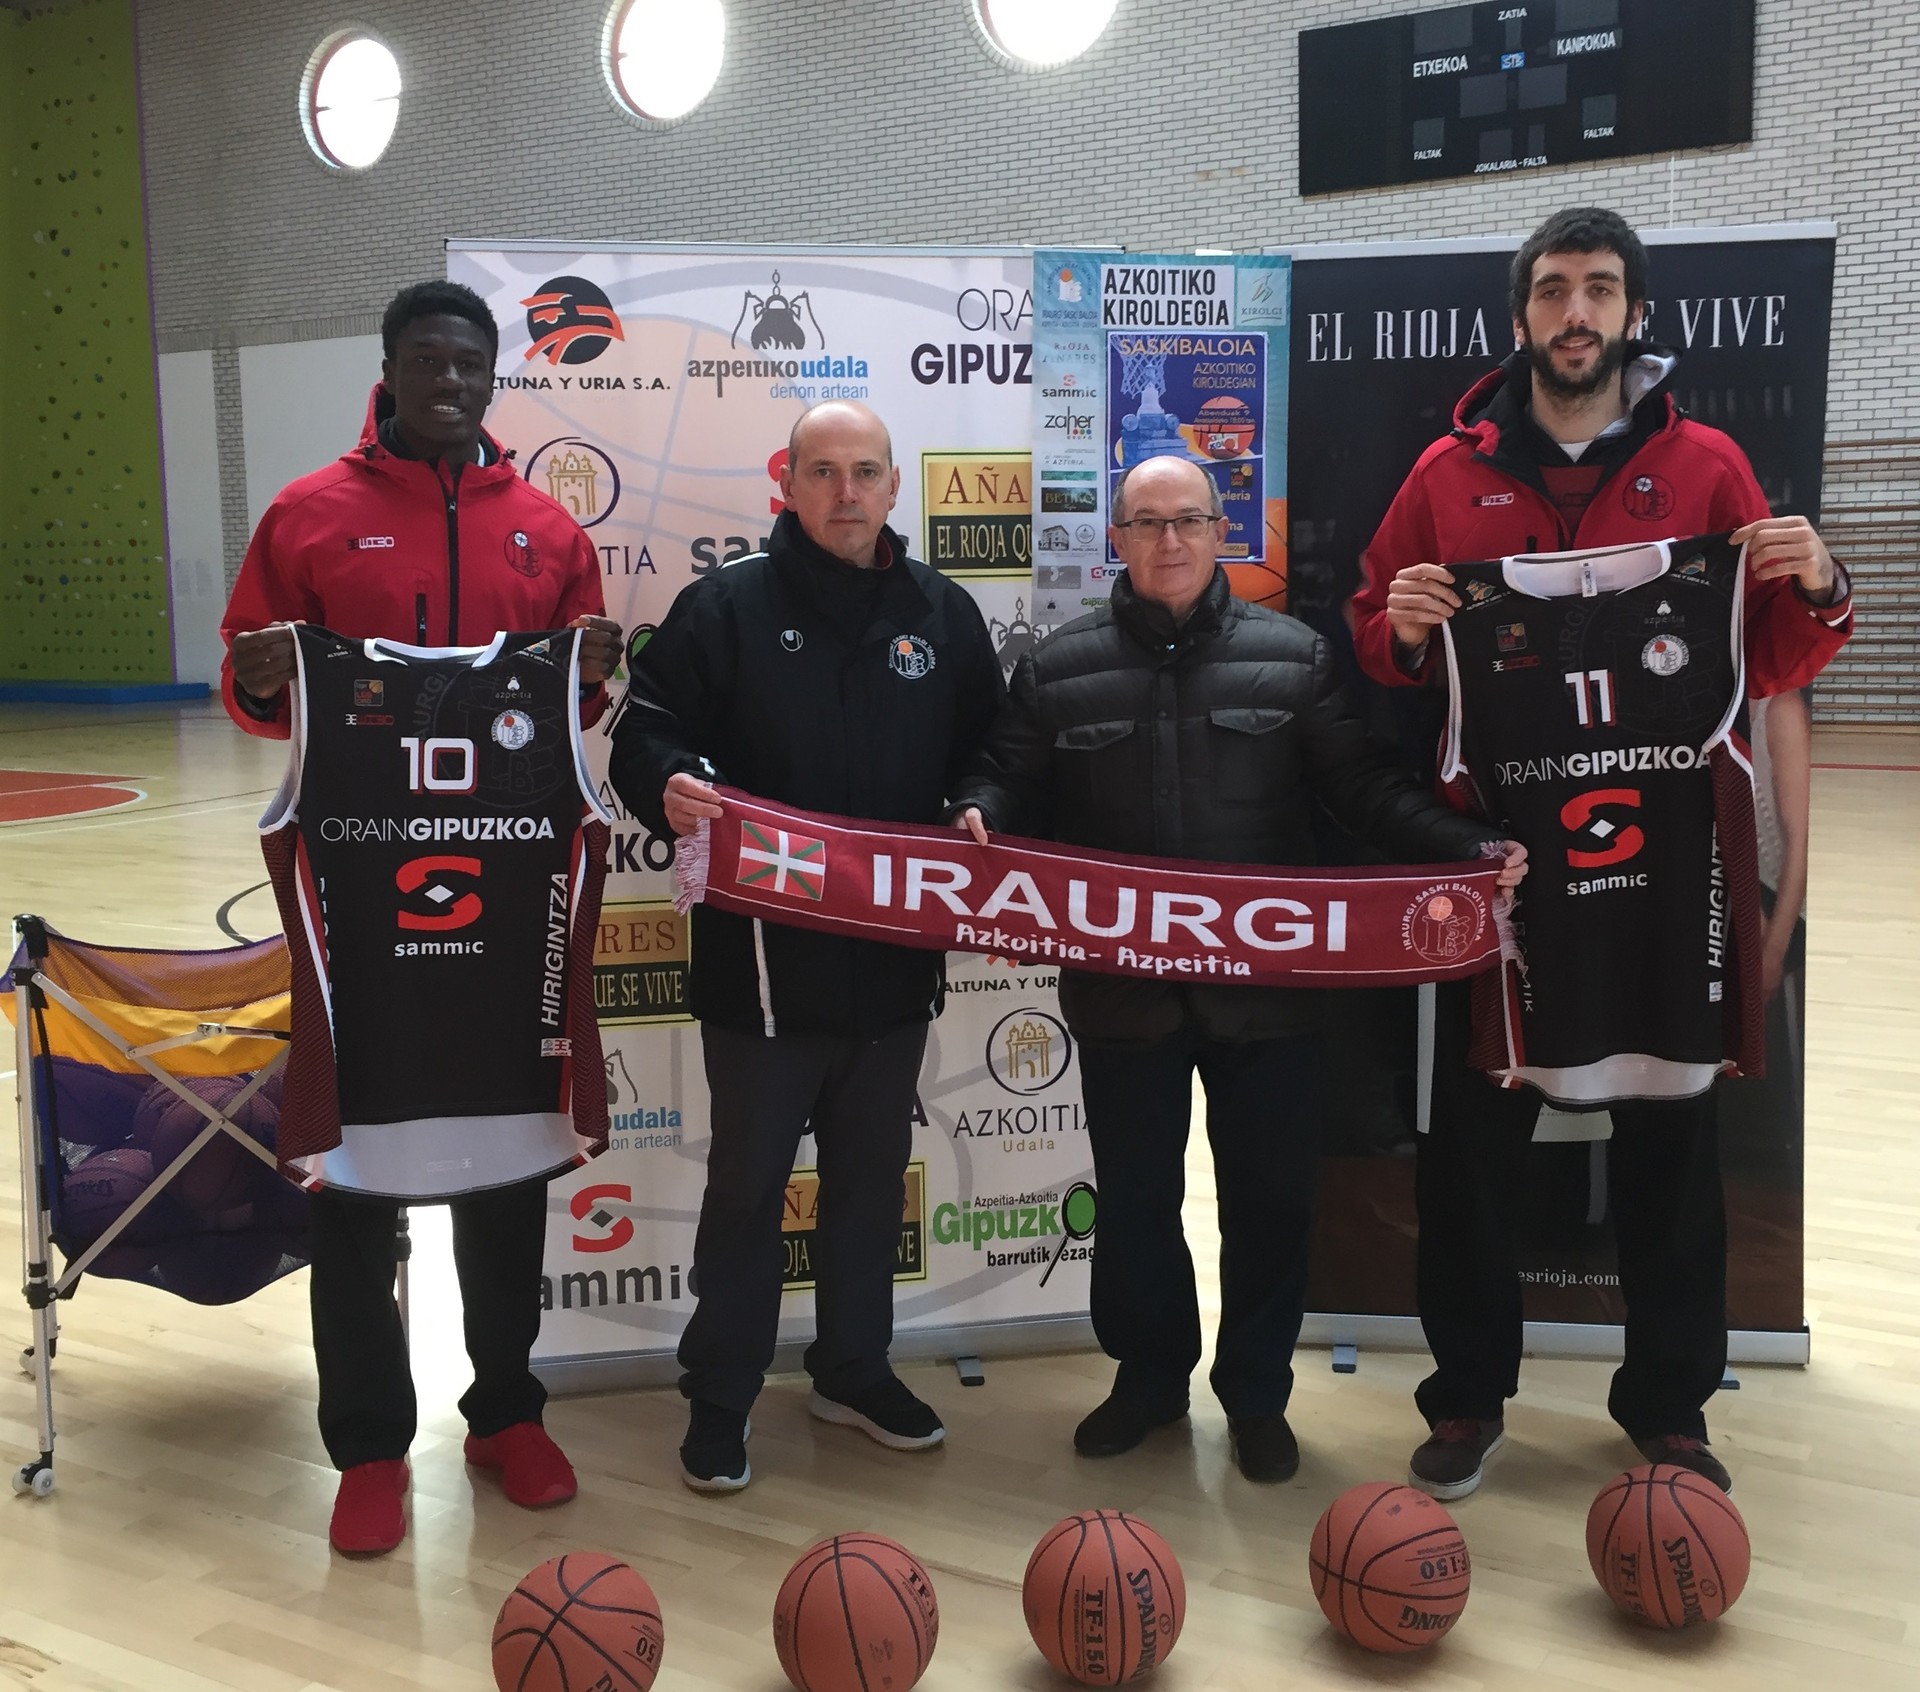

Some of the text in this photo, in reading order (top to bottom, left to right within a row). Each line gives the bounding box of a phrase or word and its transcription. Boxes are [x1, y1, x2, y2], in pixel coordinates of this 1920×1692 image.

[1498, 8, 1527, 20] ZATIA
[1556, 32, 1616, 55] KANPOKOA
[1413, 55, 1468, 77] ETXEKOA
[1584, 126, 1614, 139] FALTAK
[1414, 148, 1442, 160] FALTAK
[1104, 268, 1216, 295] AZKOITIKO
[957, 287, 1033, 332] ORA
[1103, 299, 1229, 326] KIROLDEGIA
[1241, 307, 1283, 315] KIROLGI
[1307, 311, 1353, 362] EL
[1373, 307, 1495, 360] RIOJA
[1676, 294, 1786, 349] VIVE
[1120, 338, 1256, 356] SASKIBALOIA
[911, 342, 1033, 385] GIPUZ
[1193, 362, 1256, 375] AZKOITIKO
[559, 377, 573, 390] Y
[579, 377, 625, 390] URIA
[634, 377, 671, 390] S.A.
[770, 382, 869, 399] denon artean
[1042, 387, 1097, 398] sammic
[1192, 376, 1256, 389] KIROLDEGIAN
[1044, 406, 1095, 435] zaher
[939, 463, 1030, 505] AÑA
[937, 522, 1033, 560] EL RIOJA QU
[1565, 669, 1616, 729] 11
[400, 737, 478, 794] 10
[320, 816, 555, 842] ORAINGIPUZKOA
[1567, 873, 1648, 896] sammic
[873, 853, 1347, 953] IRAURGI
[1401, 903, 1417, 951] IRAURGI
[1415, 883, 1449, 903] SASKI
[1452, 882, 1482, 902] BALOI
[394, 941, 484, 957] sammic
[541, 873, 570, 1027] HIRIGINTZA
[1118, 946, 1251, 977] Azpeitia
[594, 971, 684, 1010] UE SE VIVE
[1016, 977, 1030, 991] Y
[1035, 976, 1058, 990] UR
[634, 1132, 682, 1149] artean
[1002, 1138, 1055, 1153] Udala
[974, 1192, 1058, 1208] Azpeitia-Azkoitia
[987, 1245, 1050, 1267] barrutik
[1085, 1589, 1106, 1675] TF-150
[1126, 1568, 1157, 1680] SPALDING
